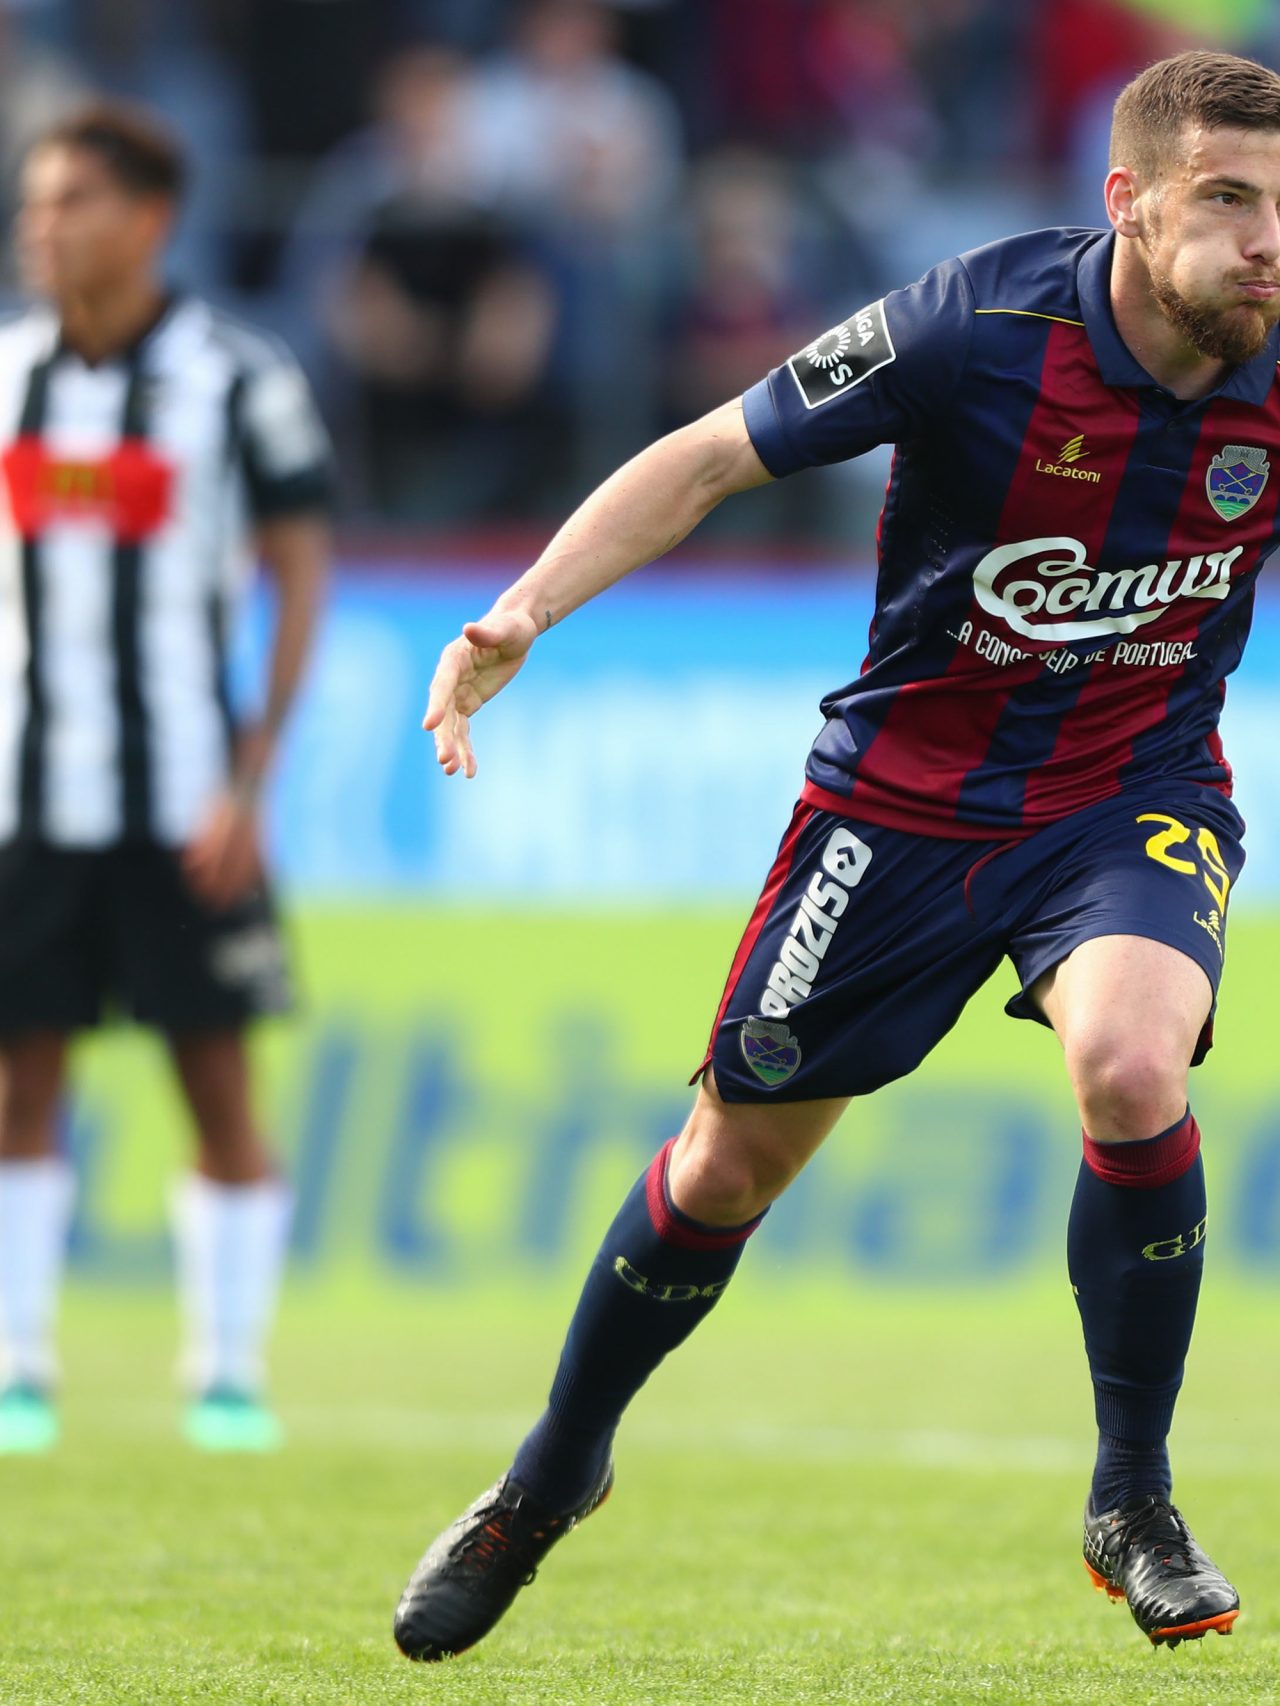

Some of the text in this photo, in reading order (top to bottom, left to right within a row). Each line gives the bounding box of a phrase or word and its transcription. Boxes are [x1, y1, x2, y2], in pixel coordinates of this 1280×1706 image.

[1035, 458, 1101, 484] Lacatoni
[973, 536, 1244, 641] Comur
[1135, 813, 1230, 917] 25
[760, 871, 849, 1019] PROZIS
